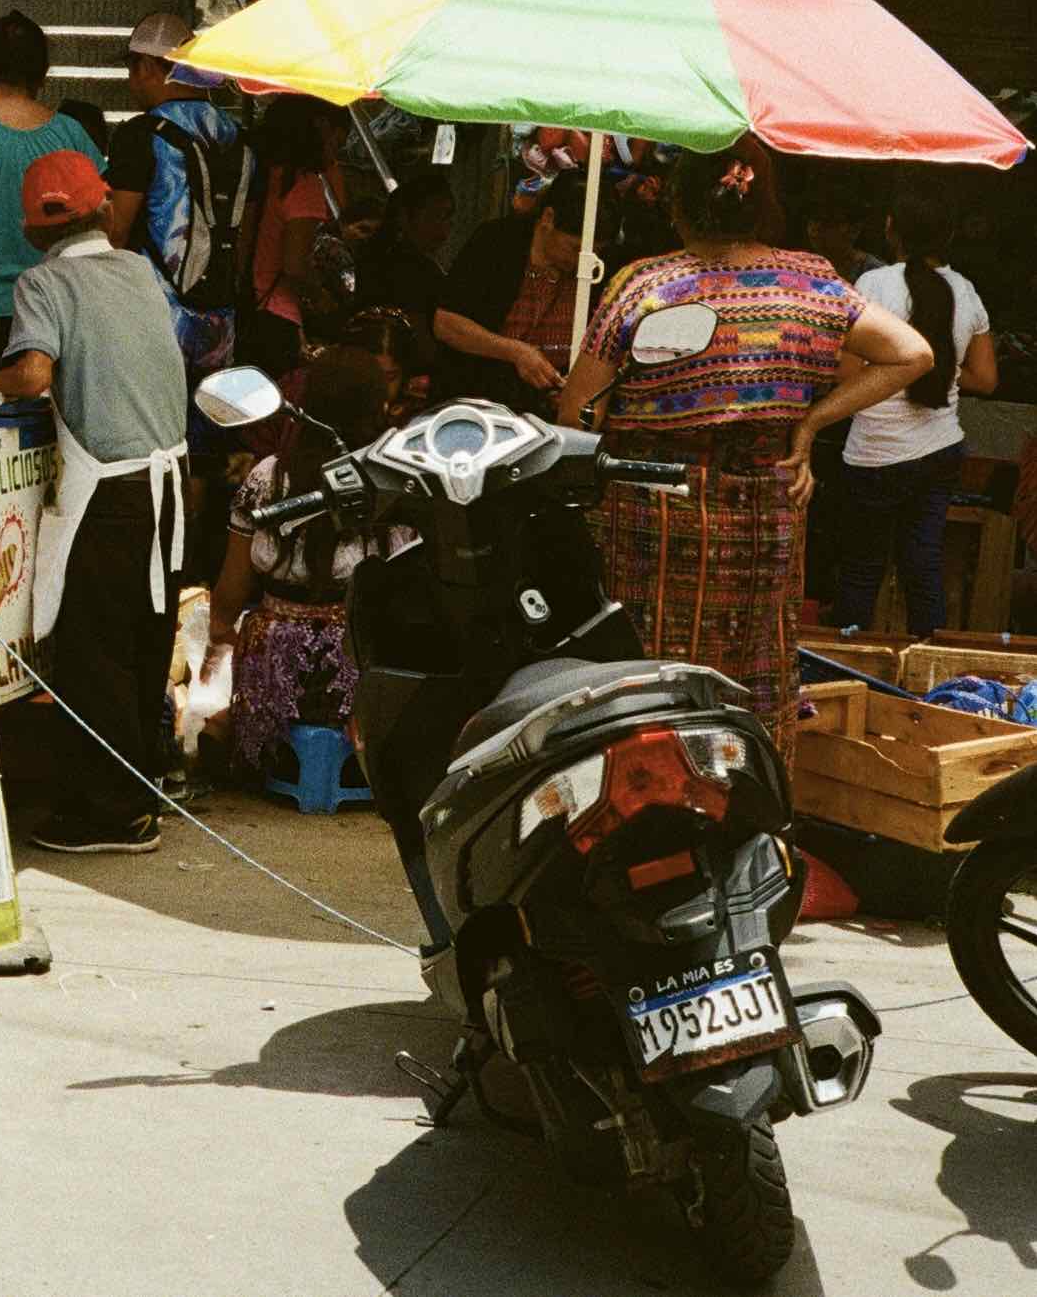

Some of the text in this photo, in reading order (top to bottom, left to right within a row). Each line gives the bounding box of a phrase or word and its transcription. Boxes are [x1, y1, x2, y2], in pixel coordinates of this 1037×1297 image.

[656, 976, 678, 992] LA
[682, 966, 711, 985] MIA
[714, 958, 735, 975] ES
[635, 976, 779, 1055] M952JJT
